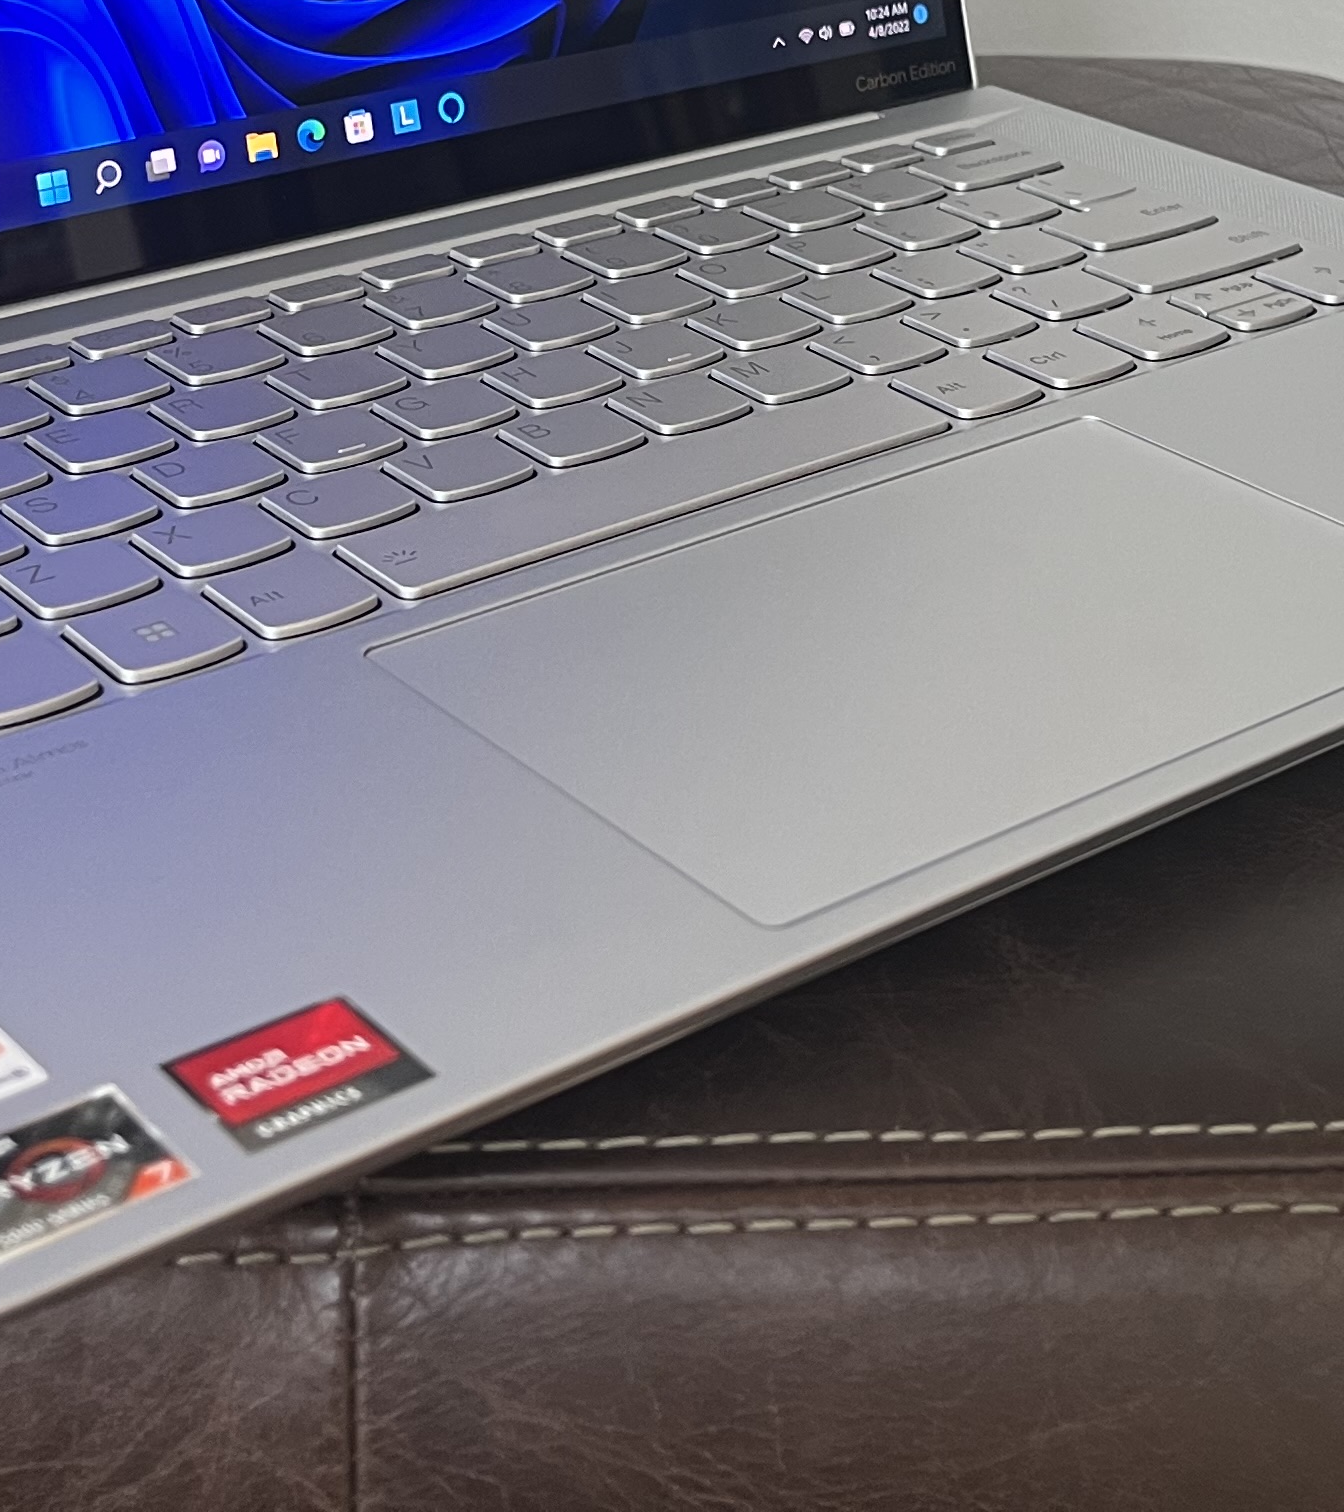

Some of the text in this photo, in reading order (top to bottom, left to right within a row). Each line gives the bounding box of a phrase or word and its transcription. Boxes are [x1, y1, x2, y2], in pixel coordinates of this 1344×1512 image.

[865, 1, 909, 22] 10:24 AM
[868, 19, 911, 39] 4/8/2022
[856, 60, 956, 93] Carbon Edition
[785, 240, 807, 252] P
[800, 291, 831, 301] L
[499, 312, 532, 327] U
[705, 312, 739, 327] K
[1157, 328, 1194, 342] Home
[397, 339, 424, 353] Y
[615, 340, 633, 354] J
[188, 360, 214, 373] 5
[1028, 351, 1068, 366] Ctrl
[283, 368, 312, 382] T
[500, 366, 538, 382] H
[729, 360, 771, 379] M
[936, 381, 968, 396] Alt
[167, 398, 204, 414] R
[394, 395, 430, 411] G
[625, 391, 663, 408] N
[45, 428, 80, 444] E
[274, 428, 301, 445] F
[517, 423, 551, 440] B
[151, 461, 186, 478] D
[403, 453, 434, 470] V
[23, 495, 58, 514] S
[285, 489, 319, 507] C
[151, 524, 193, 545] X
[15, 563, 56, 585] Z
[249, 590, 286, 608] Alt
[210, 1056, 266, 1088] AMD
[219, 1034, 371, 1106] RADEON
[145, 1159, 174, 1182] 7
